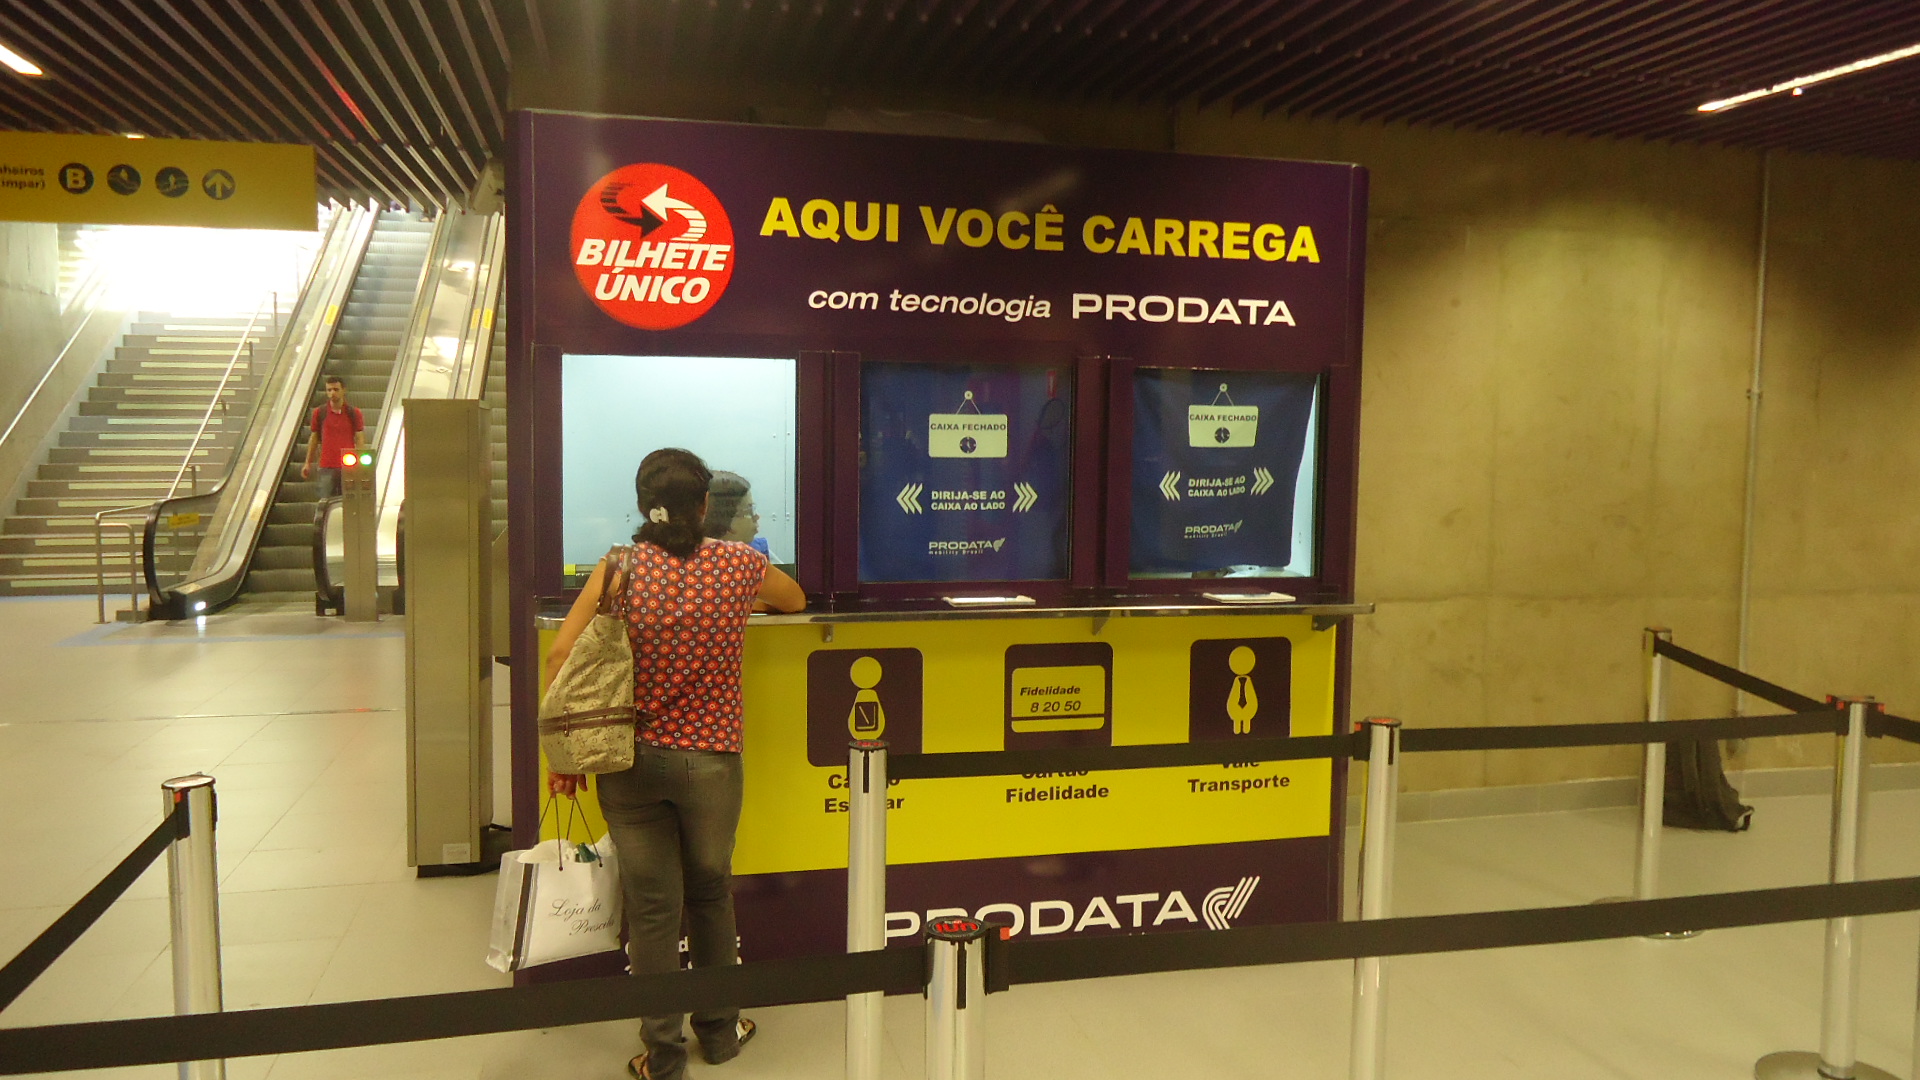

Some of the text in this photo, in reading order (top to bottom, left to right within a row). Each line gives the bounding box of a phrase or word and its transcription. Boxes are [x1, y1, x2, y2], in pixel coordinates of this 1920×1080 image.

[760, 197, 1320, 263] AQUI VOCÊ CARREGA
[576, 238, 731, 271] BILHETE
[595, 267, 710, 304] ÚNICO
[808, 289, 1296, 326] com tecnologia PRODATA
[1189, 414, 1257, 422] CAIXA FECHADO
[930, 423, 1006, 431] CAIXA FECHADO
[1188, 475, 1246, 487] DIRIJA-SE AO
[931, 490, 1006, 500] DIRIJA-SE AO
[1188, 486, 1246, 497] CAIXA AO LADO
[931, 501, 1006, 511] CAIXA AO LADO
[1185, 523, 1235, 534] PRODATA
[929, 540, 993, 550] PRODATA
[1020, 685, 1081, 696] Fidelidade
[1030, 700, 1081, 713] 8 20 50
[1187, 774, 1290, 793] Transporte
[1006, 784, 1109, 803] Fidelidade
[549, 898, 601, 922] Loja da
